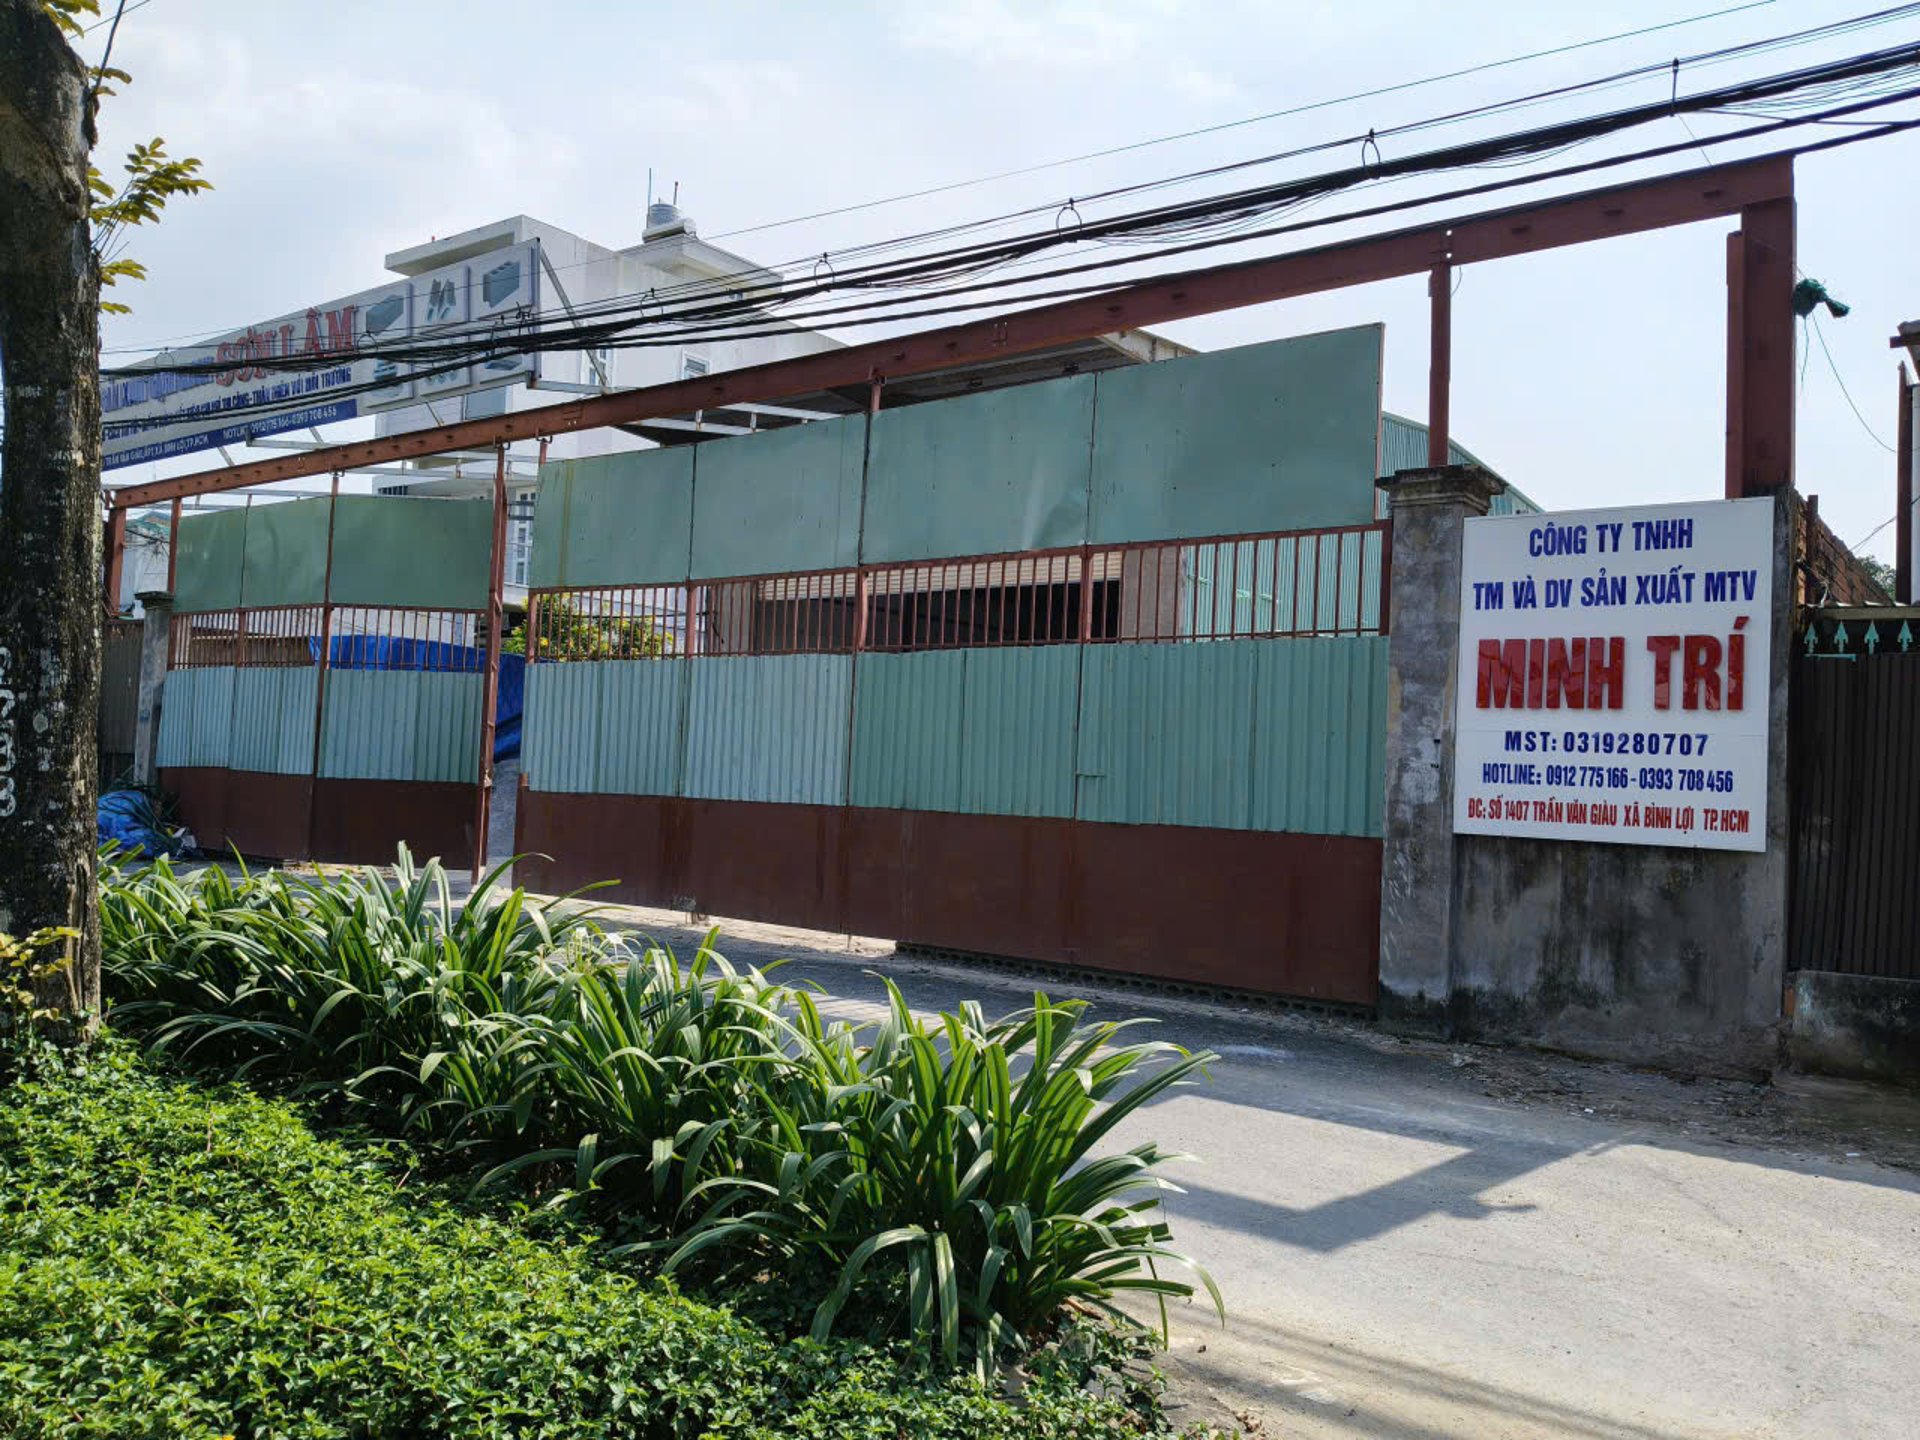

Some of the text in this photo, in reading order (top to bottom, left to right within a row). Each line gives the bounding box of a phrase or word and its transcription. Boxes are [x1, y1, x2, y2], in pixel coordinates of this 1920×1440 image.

[1529, 518, 1694, 557] CÔNG TY TNHH
[1473, 564, 1757, 610] TM VÀ DV SẢN XUẤT MTV
[1476, 616, 1750, 711] MINH TRÍ
[1504, 730, 1709, 757] MST: 0319280707
[1482, 763, 1541, 786] HOTLINE:
[1546, 765, 1576, 787] 0912
[1488, 794, 1503, 819] SỐ
[1504, 800, 1530, 821] 1407
[1566, 799, 1587, 824] VĂN
[1590, 800, 1617, 826] GIÀU
[1623, 801, 1640, 827] XÃ
[1644, 803, 1671, 829] BÌNH
[1676, 806, 1694, 834] LỢI
